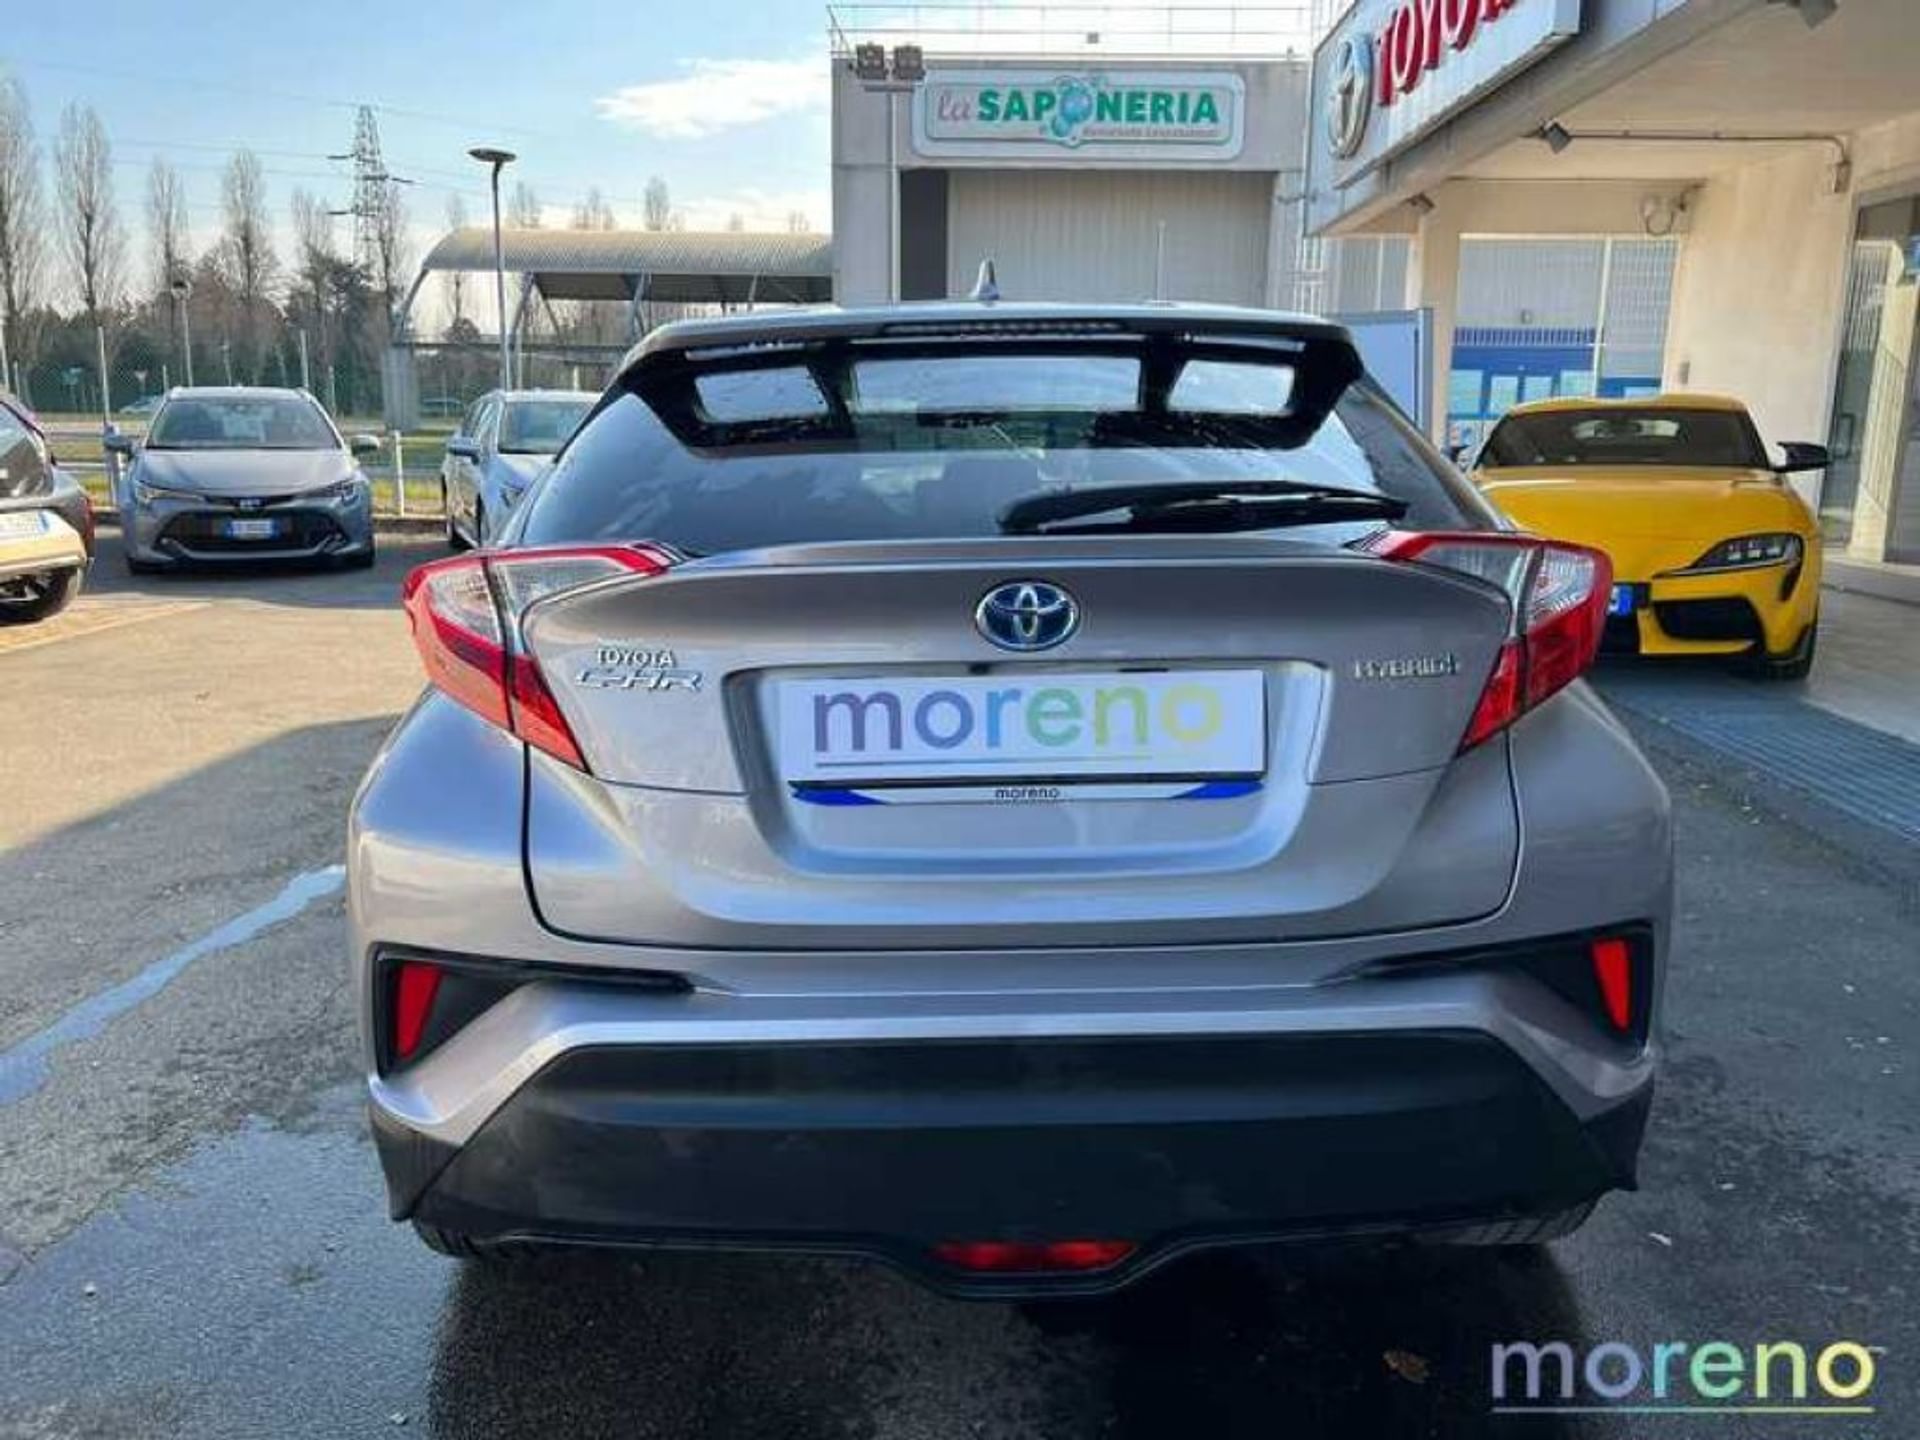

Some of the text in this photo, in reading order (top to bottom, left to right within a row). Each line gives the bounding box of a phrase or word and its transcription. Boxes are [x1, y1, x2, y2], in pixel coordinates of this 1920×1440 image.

[1378, 0, 1516, 107] TOYO
[976, 87, 1219, 123] SAPONERIA
[597, 648, 675, 668] TOYOTA
[813, 681, 1223, 752] moreno
[995, 786, 1060, 799] moreno
